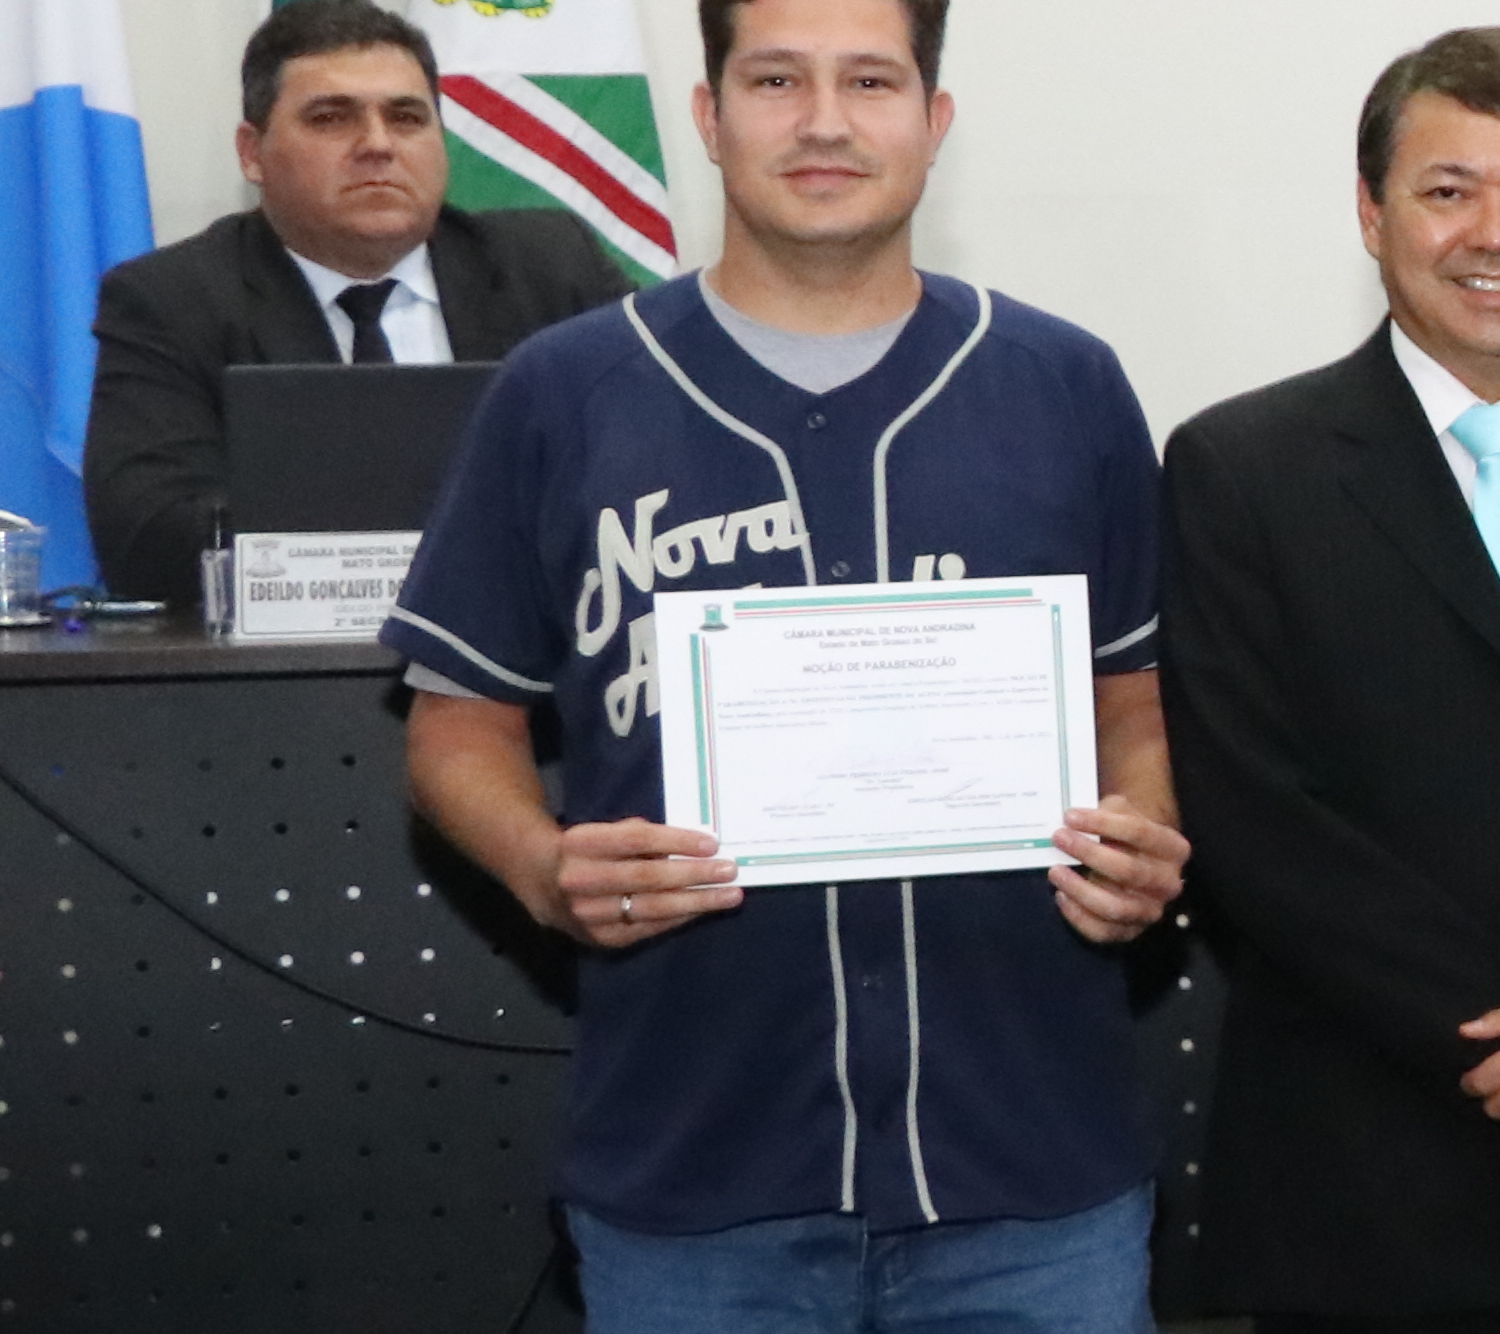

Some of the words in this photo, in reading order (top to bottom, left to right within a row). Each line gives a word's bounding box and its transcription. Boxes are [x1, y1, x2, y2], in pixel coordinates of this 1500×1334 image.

[575, 488, 809, 657] Nova
[250, 581, 304, 602] EDEILDO
[308, 578, 384, 603] GONÇALVES
[879, 625, 891, 635] DE
[802, 660, 843, 675] MOÇÃO
[847, 661, 861, 671] DE
[864, 656, 957, 671] PARABENIZAÇÃO
